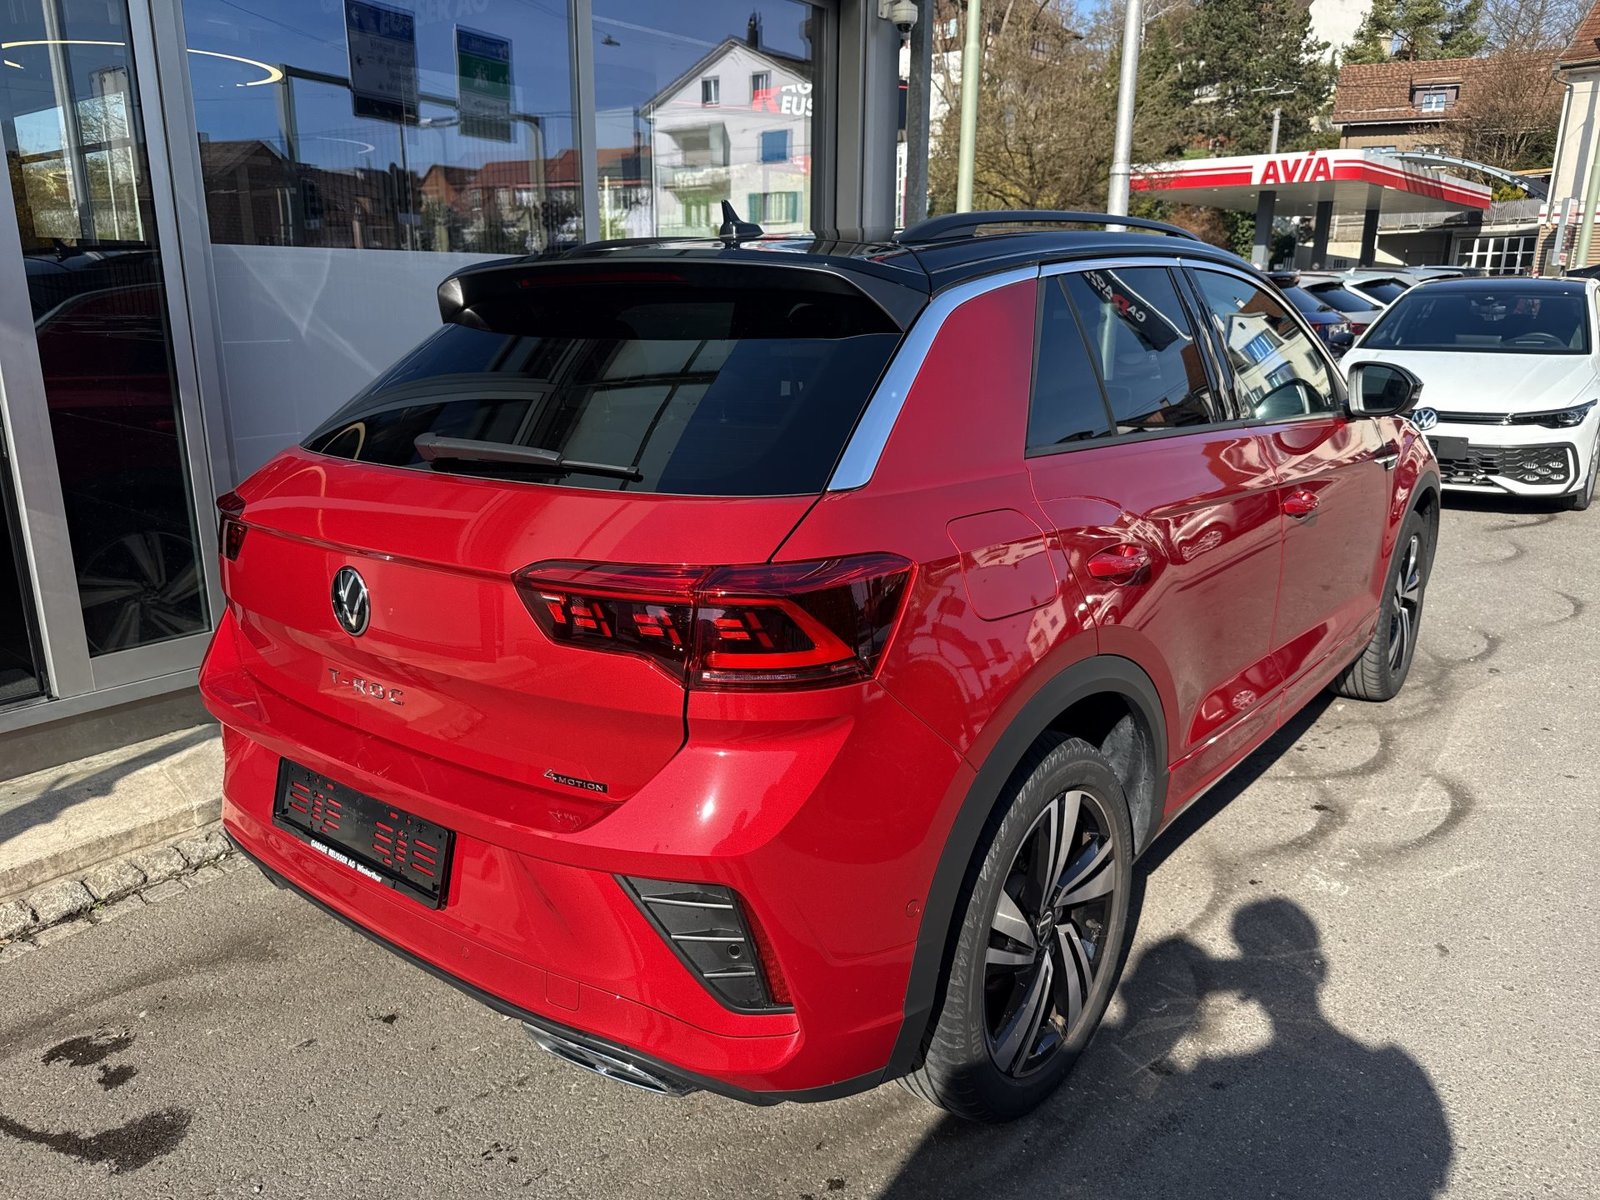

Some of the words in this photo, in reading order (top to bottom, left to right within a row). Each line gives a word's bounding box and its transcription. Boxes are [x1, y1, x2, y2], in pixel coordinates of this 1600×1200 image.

[1260, 151, 1332, 184] AVIA
[328, 668, 404, 706] T-ROC
[543, 768, 604, 792] 4MOTION
[310, 839, 328, 854] GARAGE
